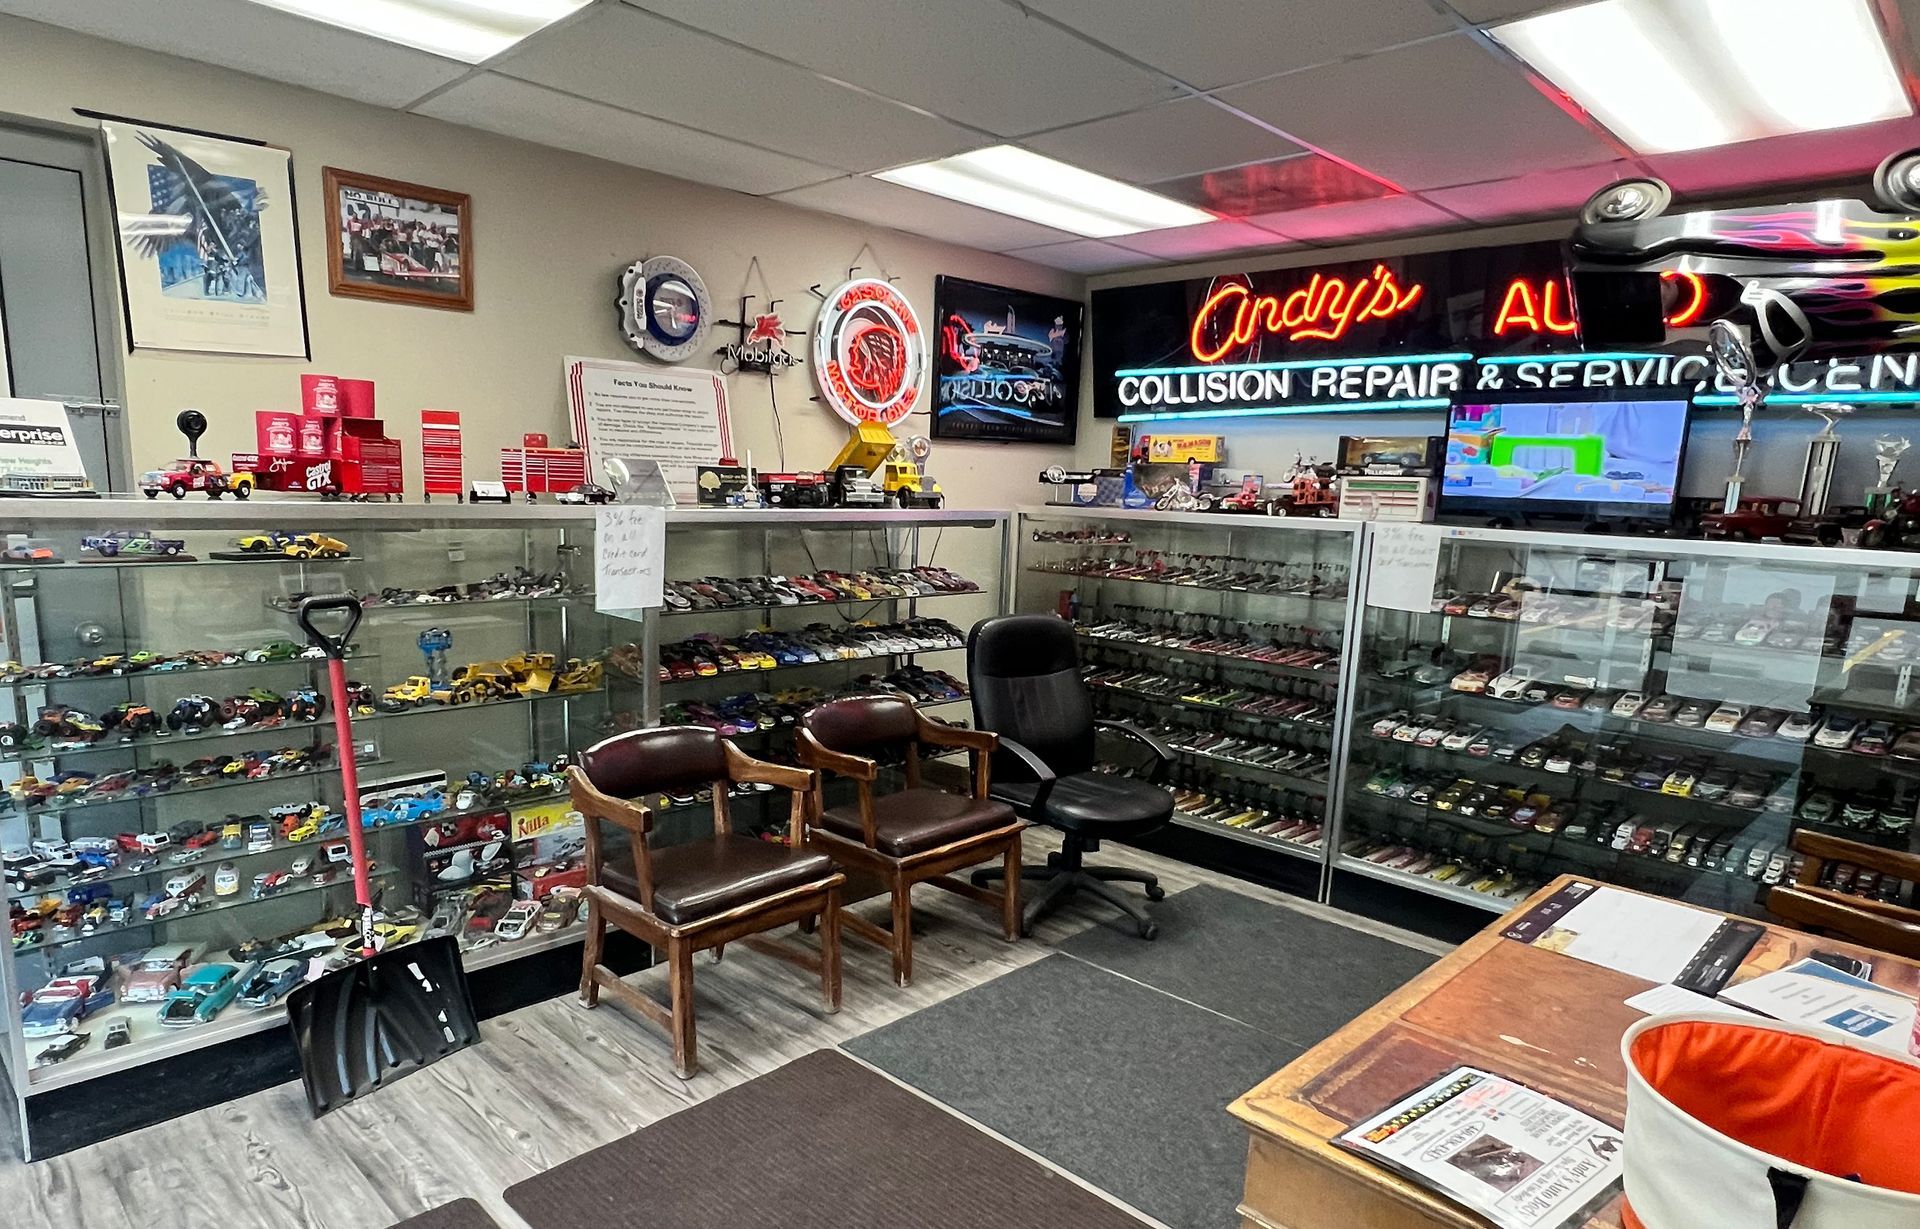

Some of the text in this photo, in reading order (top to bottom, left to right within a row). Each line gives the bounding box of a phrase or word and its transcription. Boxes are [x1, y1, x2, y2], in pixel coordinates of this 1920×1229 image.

[1191, 264, 1422, 362] Andy's
[1493, 271, 1702, 335] AUO
[612, 378, 632, 387] Facts
[633, 380, 648, 389] You
[648, 382, 673, 391] Should
[826, 359, 880, 423] MOTOR
[1117, 367, 1290, 406] COLLISION
[1310, 362, 1461, 400] REPAIR
[1477, 362, 1504, 390] &
[305, 460, 332, 478] Castrol
[306, 472, 332, 491] GTX
[604, 510, 624, 528] 3%
[518, 815, 550, 838] Nilla
[1541, 1180, 1571, 1198] Auto
[1518, 1196, 1552, 1218] Body
